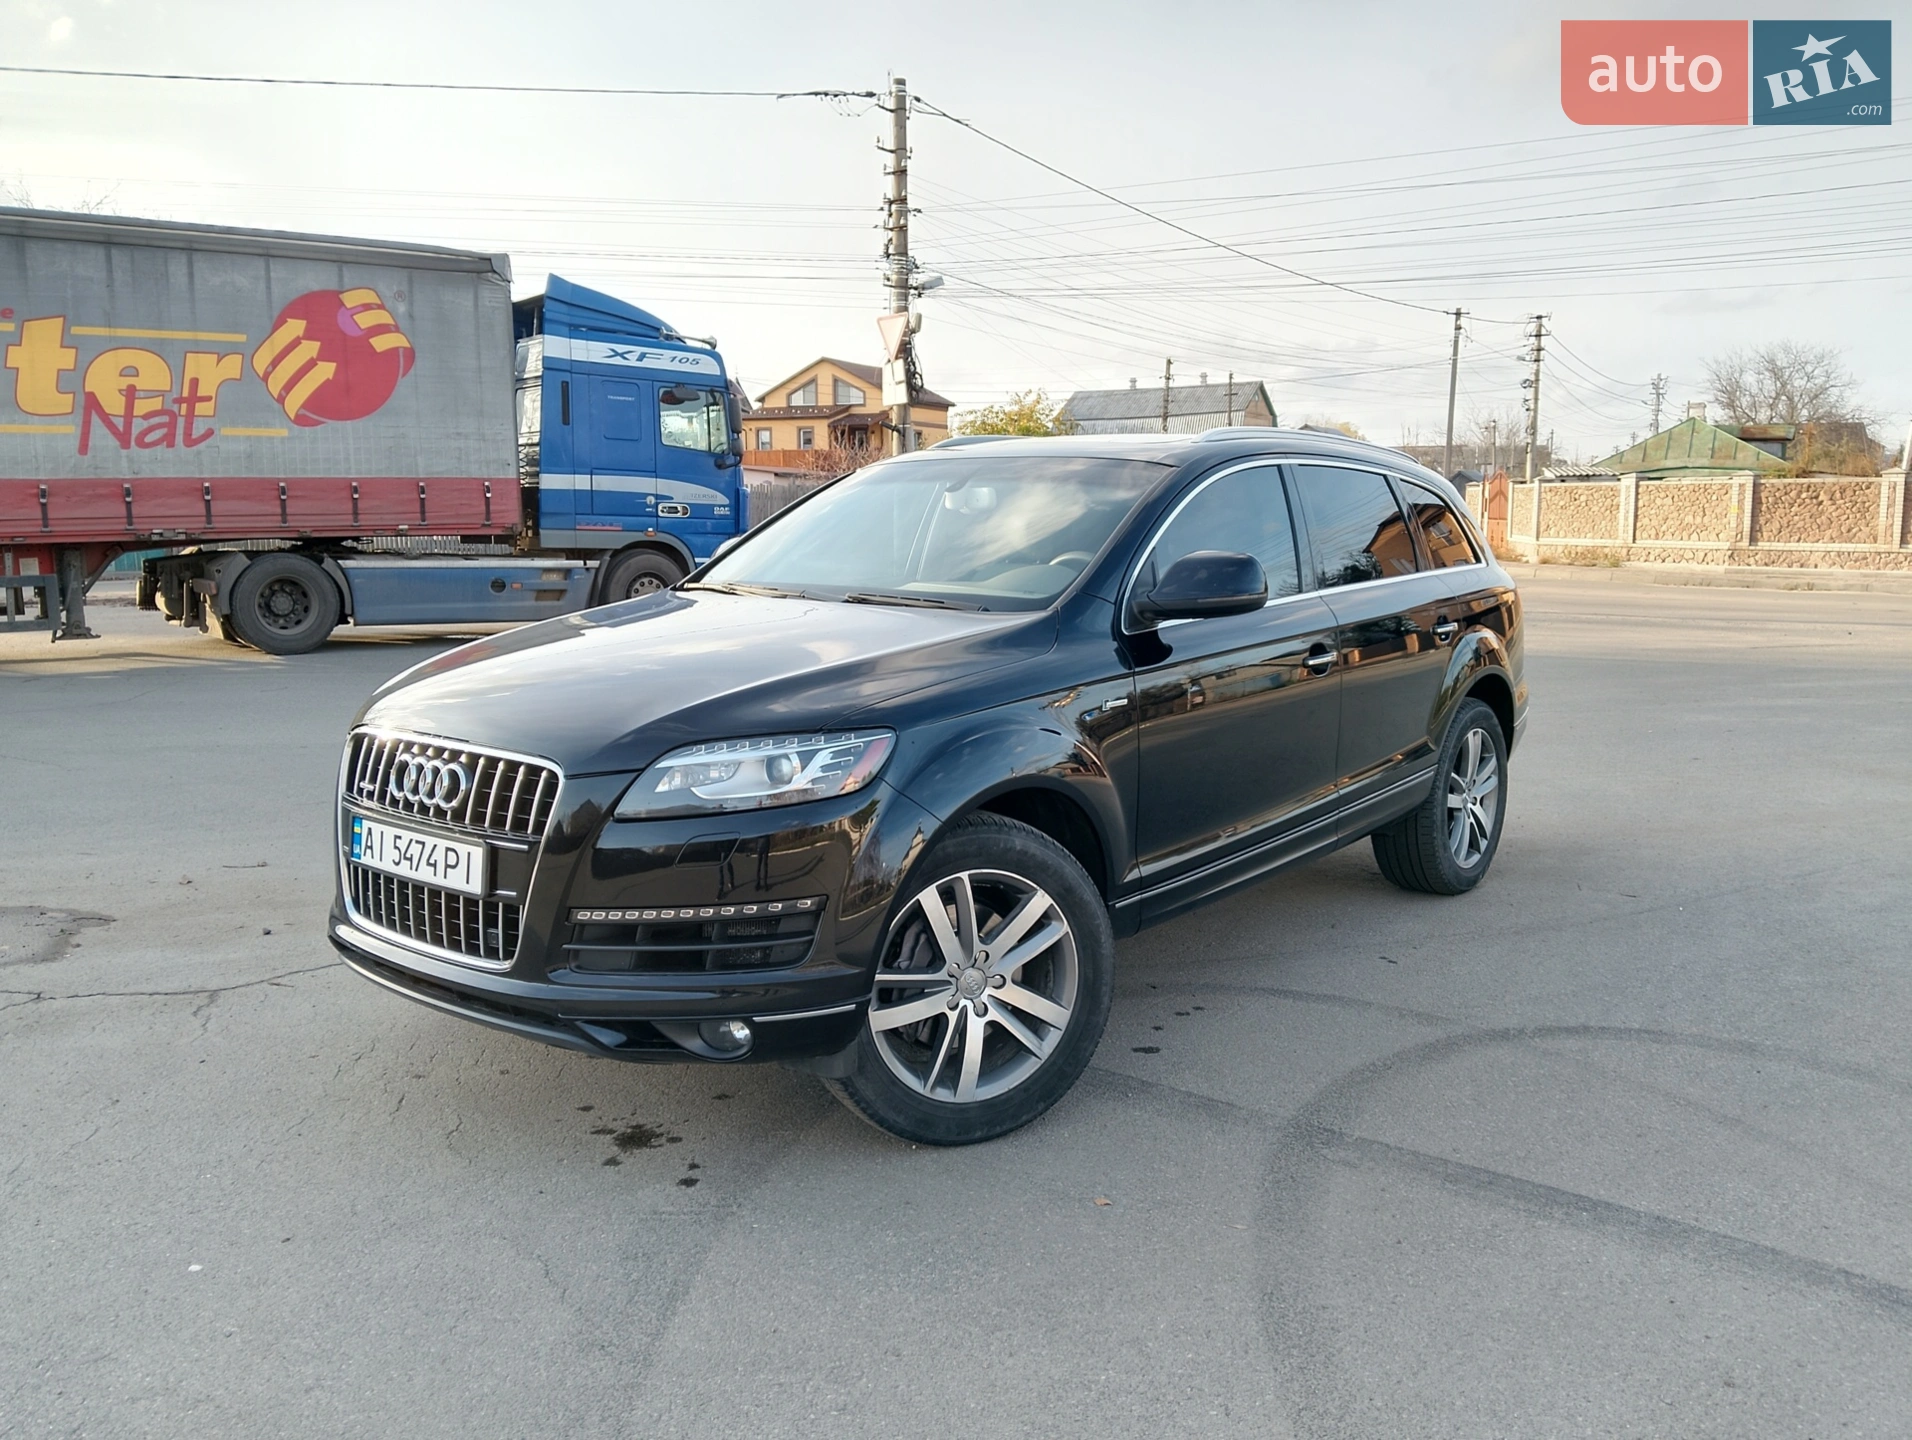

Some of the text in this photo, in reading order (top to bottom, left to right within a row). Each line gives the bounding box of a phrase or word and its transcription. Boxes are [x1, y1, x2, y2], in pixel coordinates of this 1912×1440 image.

[5, 315, 244, 417] ter
[602, 348, 701, 366] XF 105
[78, 377, 214, 456] Nat
[364, 827, 383, 862] AI
